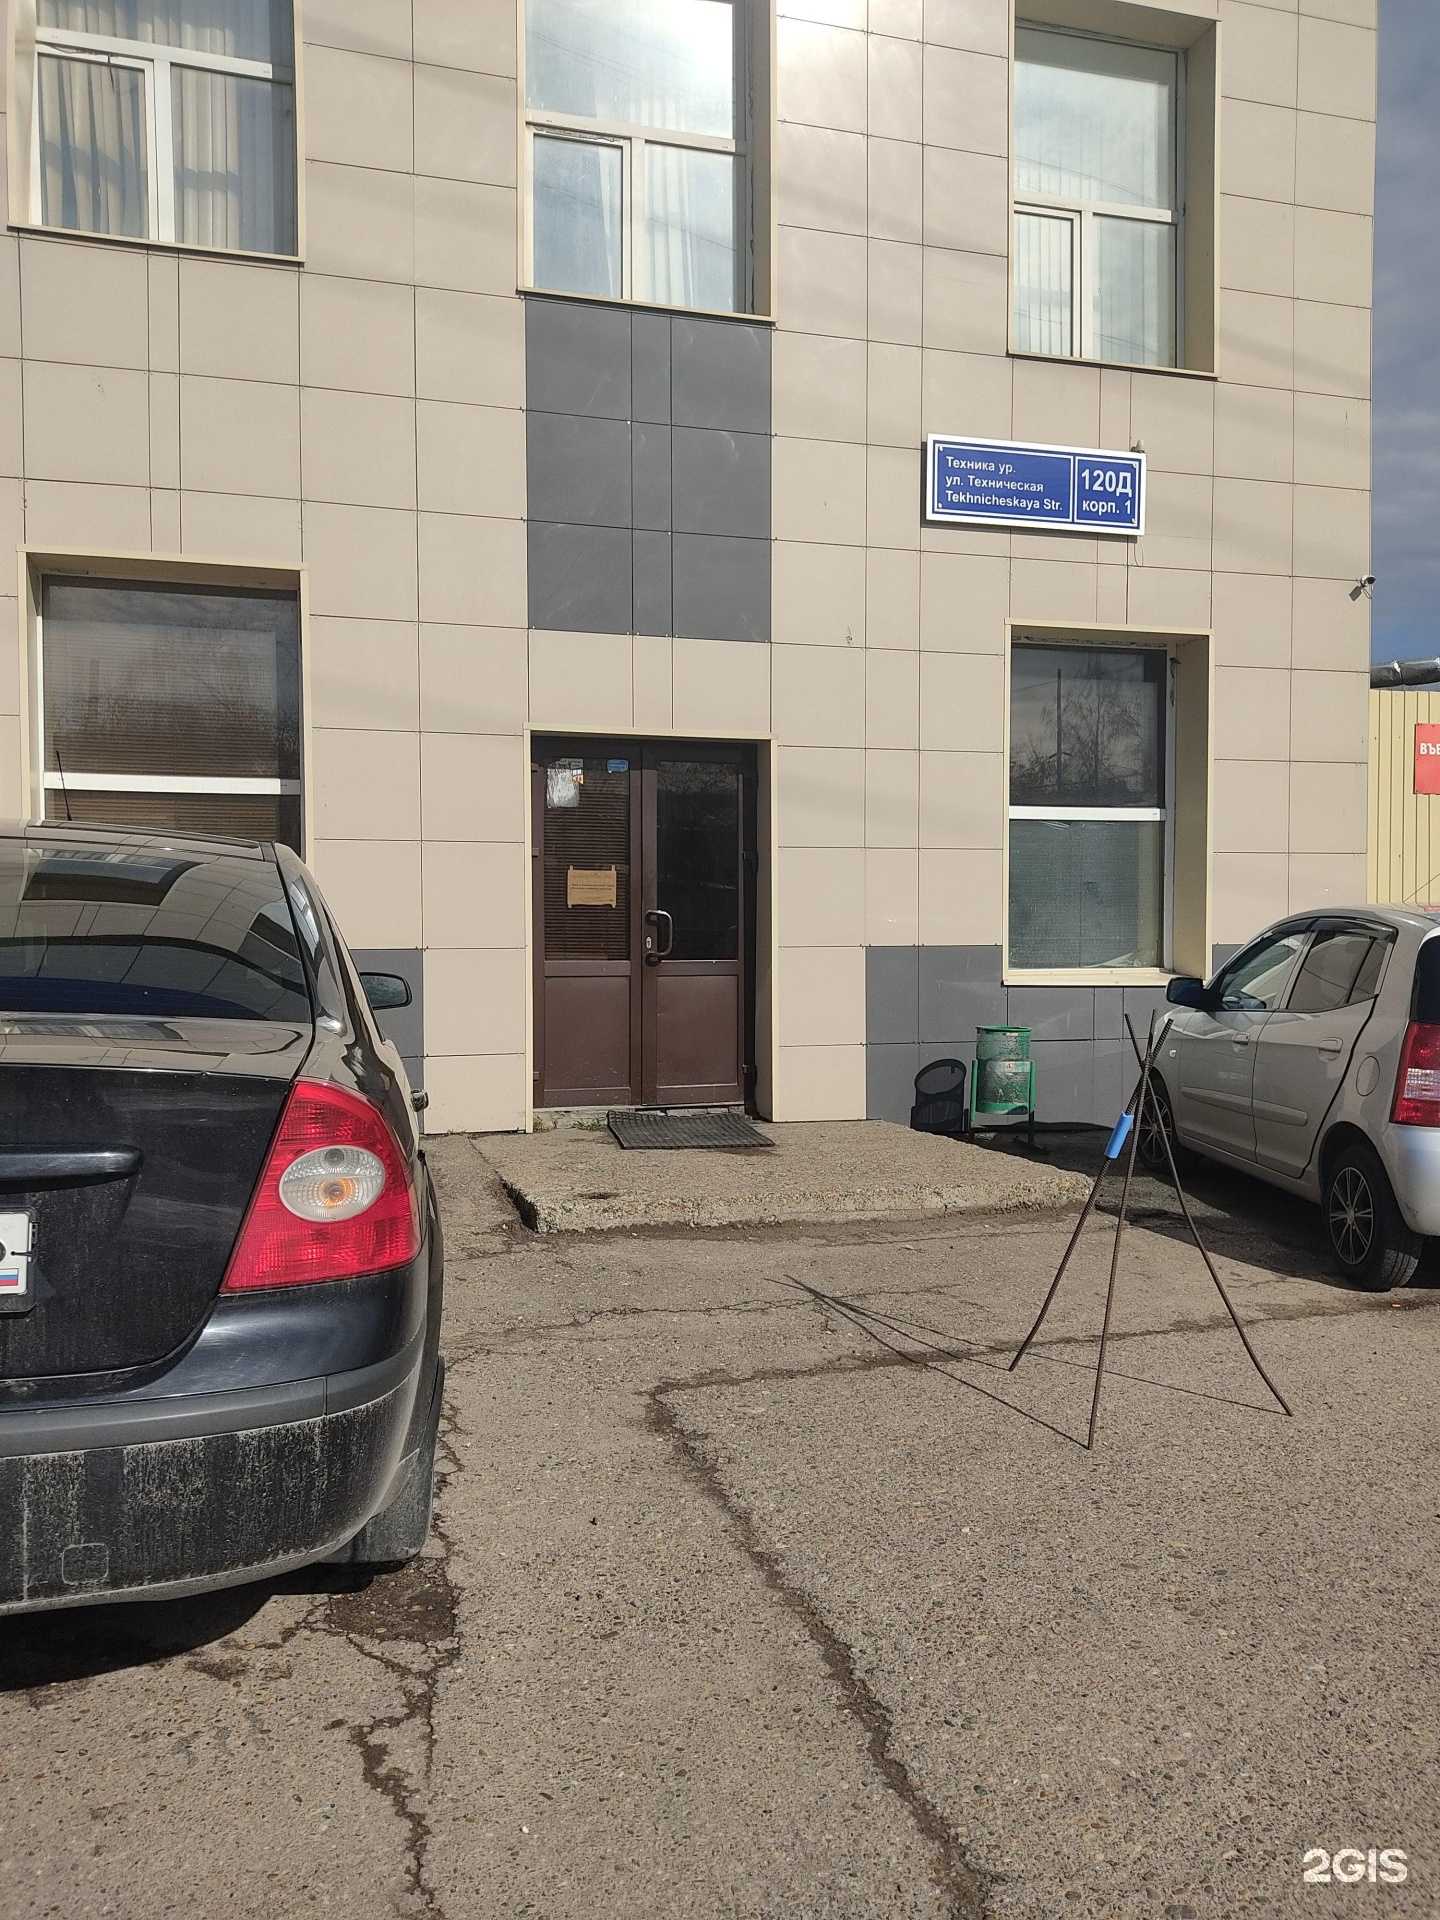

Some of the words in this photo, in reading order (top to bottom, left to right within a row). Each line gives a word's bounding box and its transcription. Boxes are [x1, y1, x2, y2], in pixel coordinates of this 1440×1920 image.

[945, 455, 995, 471] Техника
[998, 463, 1016, 475] ур.
[945, 475, 964, 488] ул.
[967, 474, 1044, 493] Техническая
[1081, 468, 1133, 498] 120Д
[945, 490, 1040, 511] Tekhnicheskaya
[1043, 498, 1063, 511] Str.
[1082, 500, 1120, 516] корп.
[1124, 500, 1131, 515] 1
